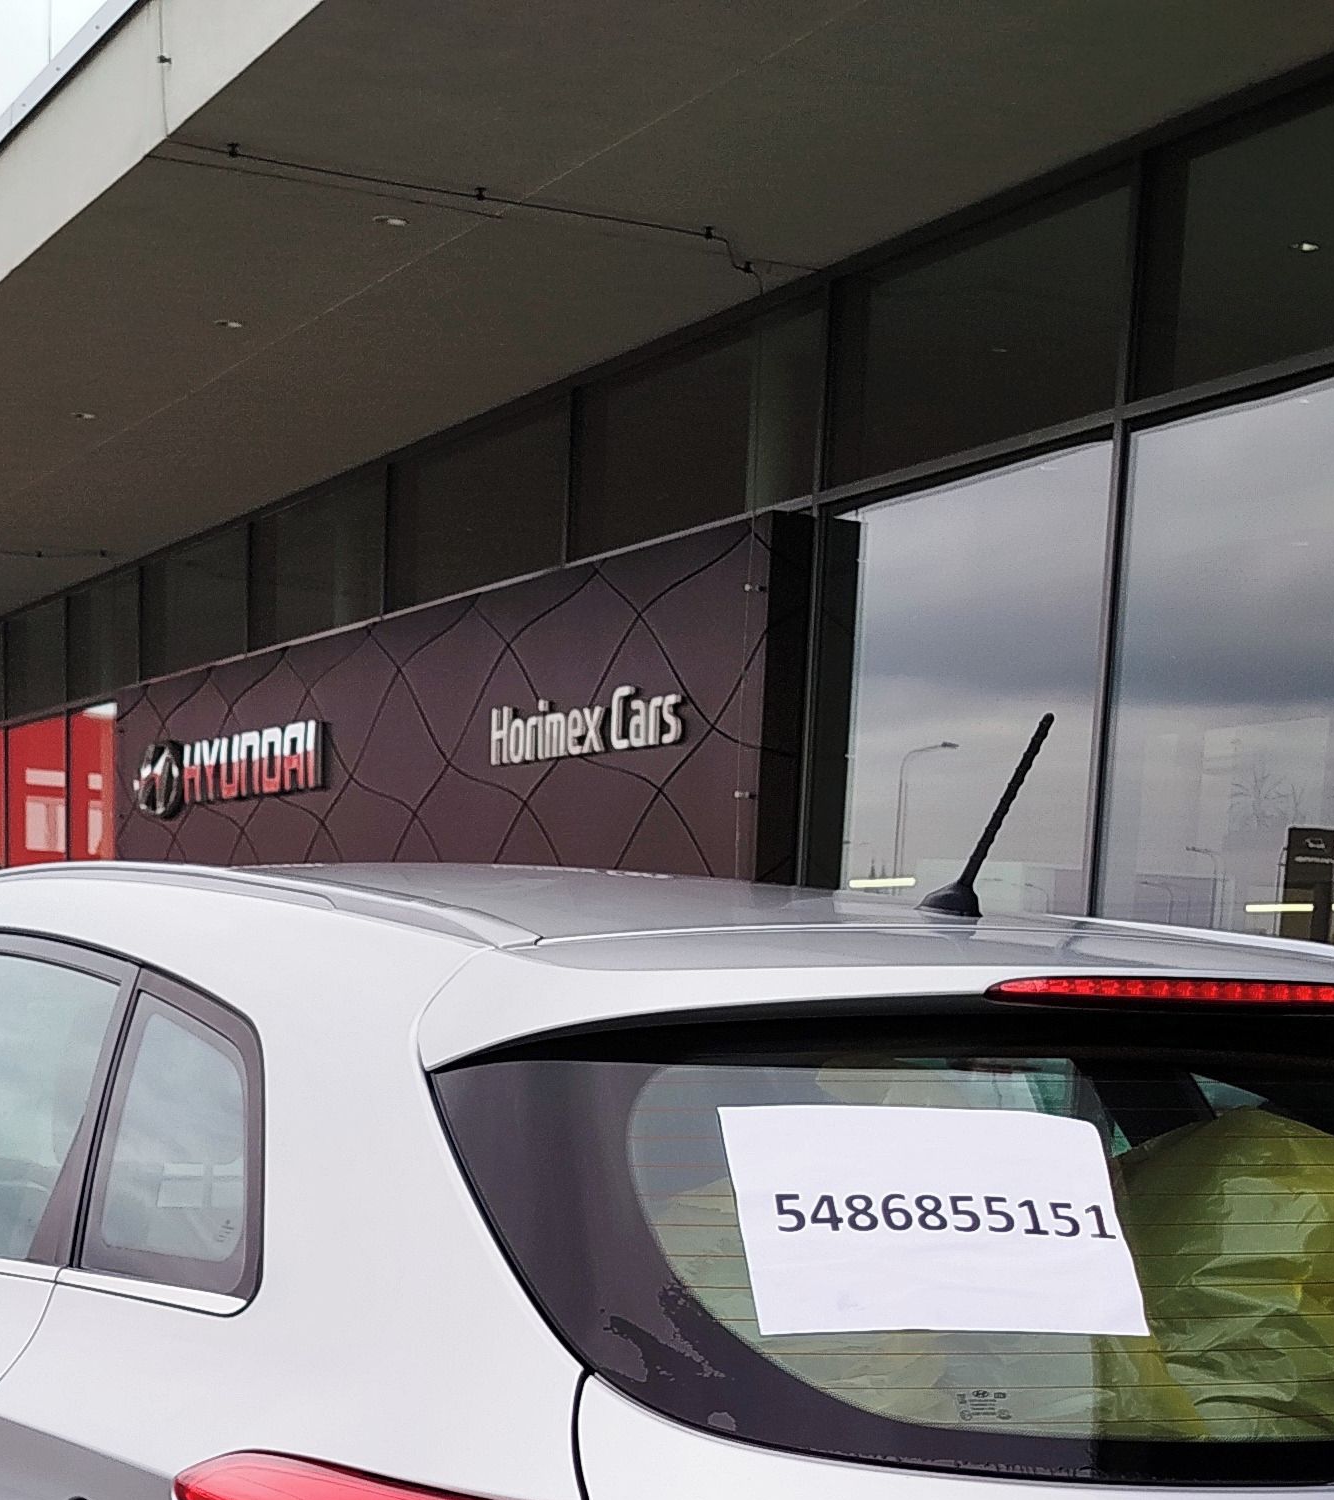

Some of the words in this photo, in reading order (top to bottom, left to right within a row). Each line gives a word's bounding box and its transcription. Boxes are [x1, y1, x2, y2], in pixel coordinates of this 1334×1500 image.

[183, 719, 320, 801] HYUNDAI
[489, 701, 605, 766] Horimex
[609, 685, 683, 750] Cars
[775, 1193, 1116, 1239] 5486855151
